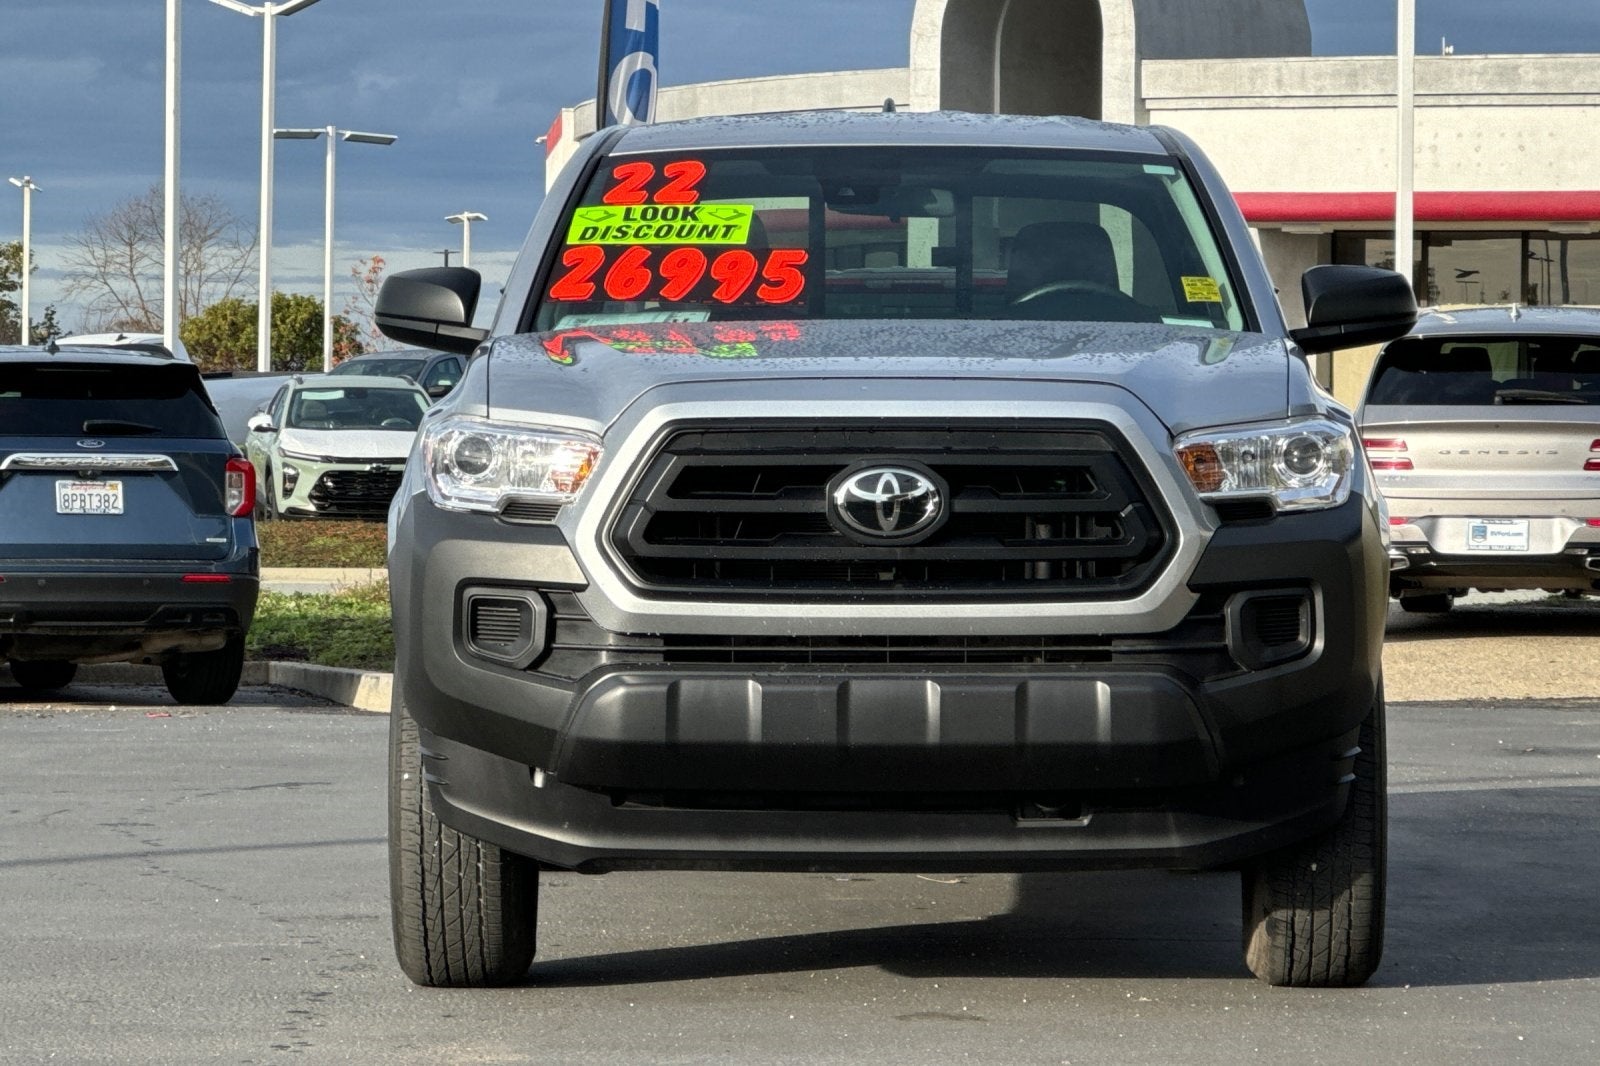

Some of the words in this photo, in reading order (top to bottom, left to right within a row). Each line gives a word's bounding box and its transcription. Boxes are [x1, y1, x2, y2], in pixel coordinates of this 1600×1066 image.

[603, 160, 706, 205] 22
[623, 206, 702, 222] LOOK
[578, 224, 741, 241] DISCOUNT
[550, 245, 809, 304] 26995
[62, 493, 119, 510] 8PBT382
